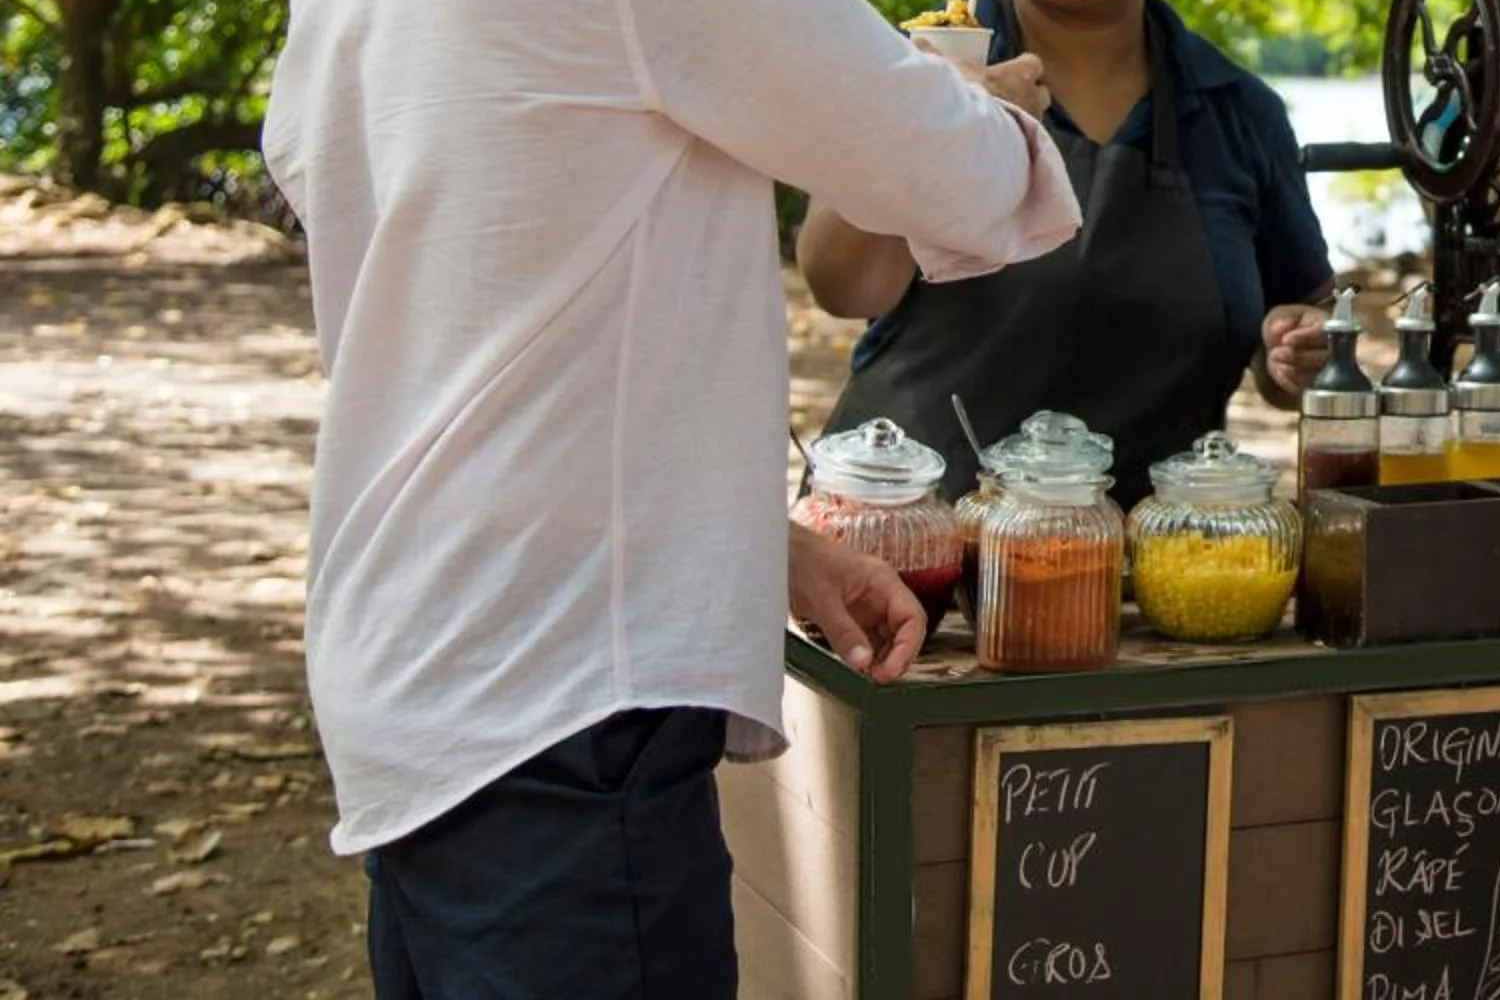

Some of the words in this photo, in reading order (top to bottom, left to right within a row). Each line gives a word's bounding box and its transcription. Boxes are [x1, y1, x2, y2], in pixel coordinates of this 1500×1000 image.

[1002, 762, 1110, 824] PETIT
[1019, 832, 1096, 889] CUP
[1008, 938, 1110, 985] GROS
